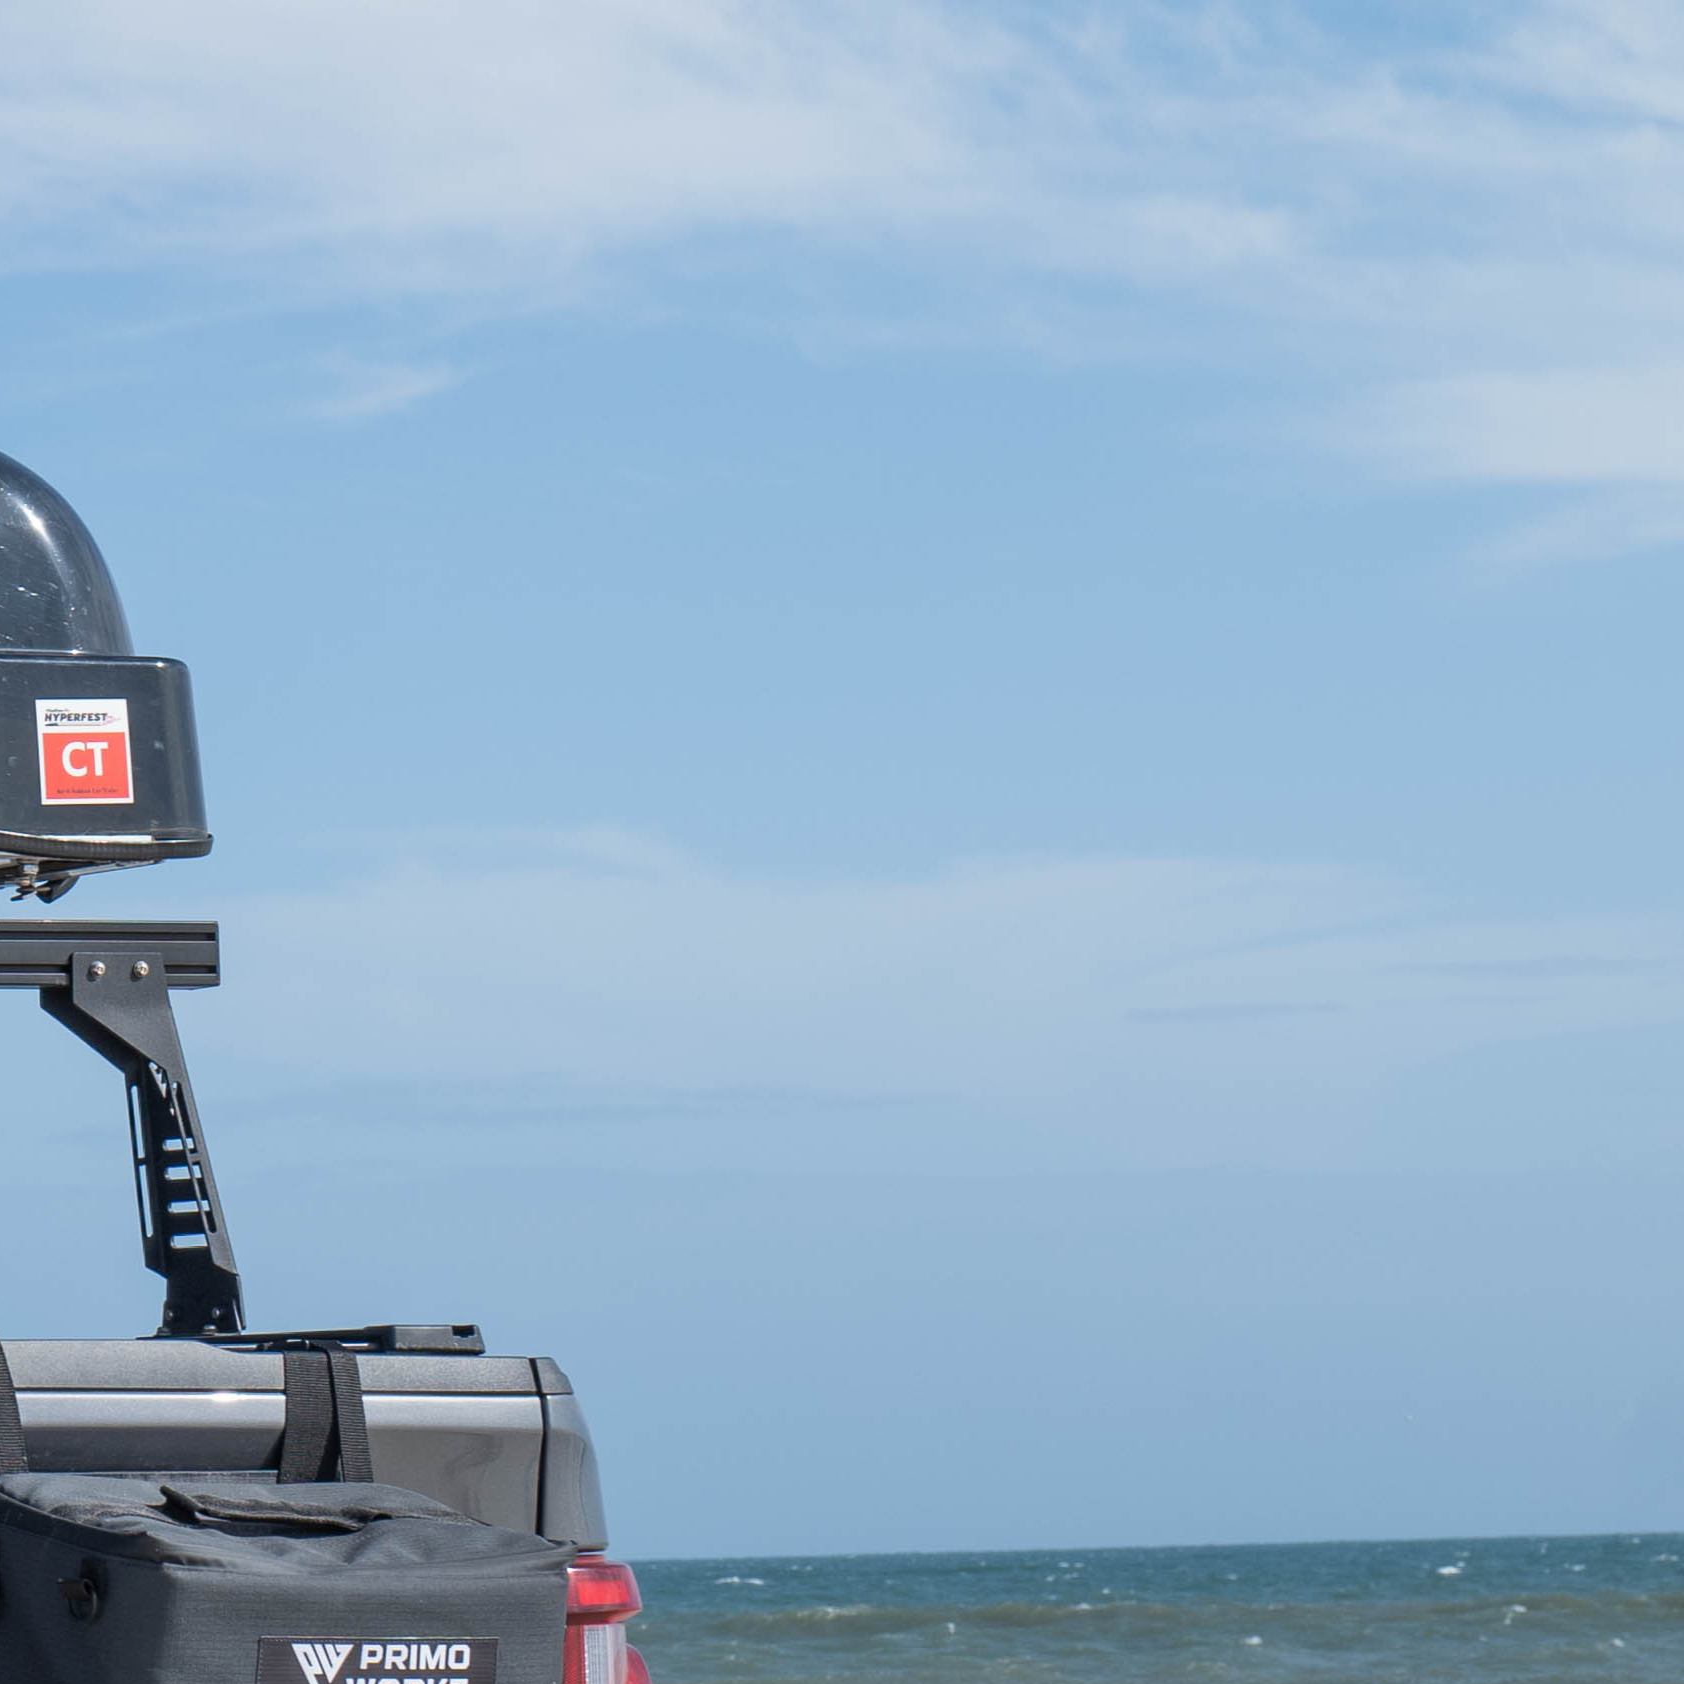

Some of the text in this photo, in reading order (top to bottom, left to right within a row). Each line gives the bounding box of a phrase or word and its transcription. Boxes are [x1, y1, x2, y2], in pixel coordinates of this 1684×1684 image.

[44, 712, 108, 722] HYPERFEST
[61, 740, 109, 778] CT
[359, 1643, 471, 1671] PRIMO
